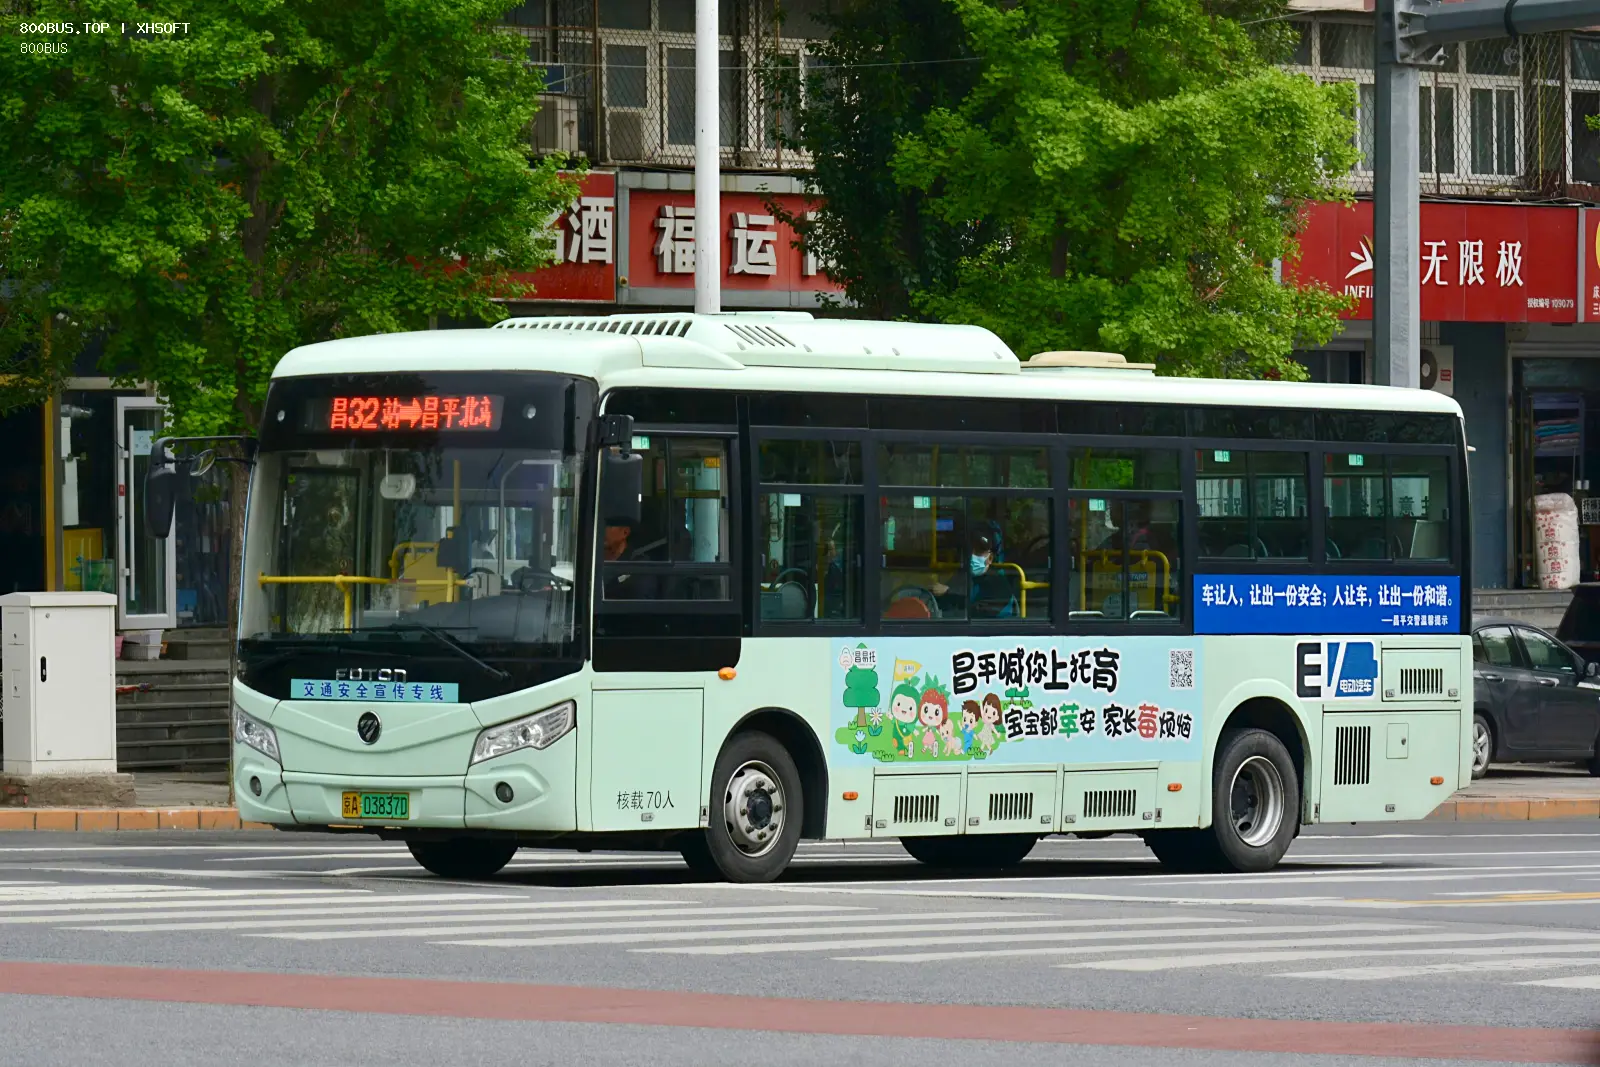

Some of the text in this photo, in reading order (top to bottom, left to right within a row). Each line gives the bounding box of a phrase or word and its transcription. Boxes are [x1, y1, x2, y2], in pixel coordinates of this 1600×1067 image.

[1421, 239, 1524, 288] 无限极
[951, 647, 1120, 694] 昌平喊你上托育
[1339, 679, 1372, 693] 电动汽车
[303, 681, 444, 701] 交通安全宣传专线
[1103, 702, 1193, 739] 家长莓烦恼
